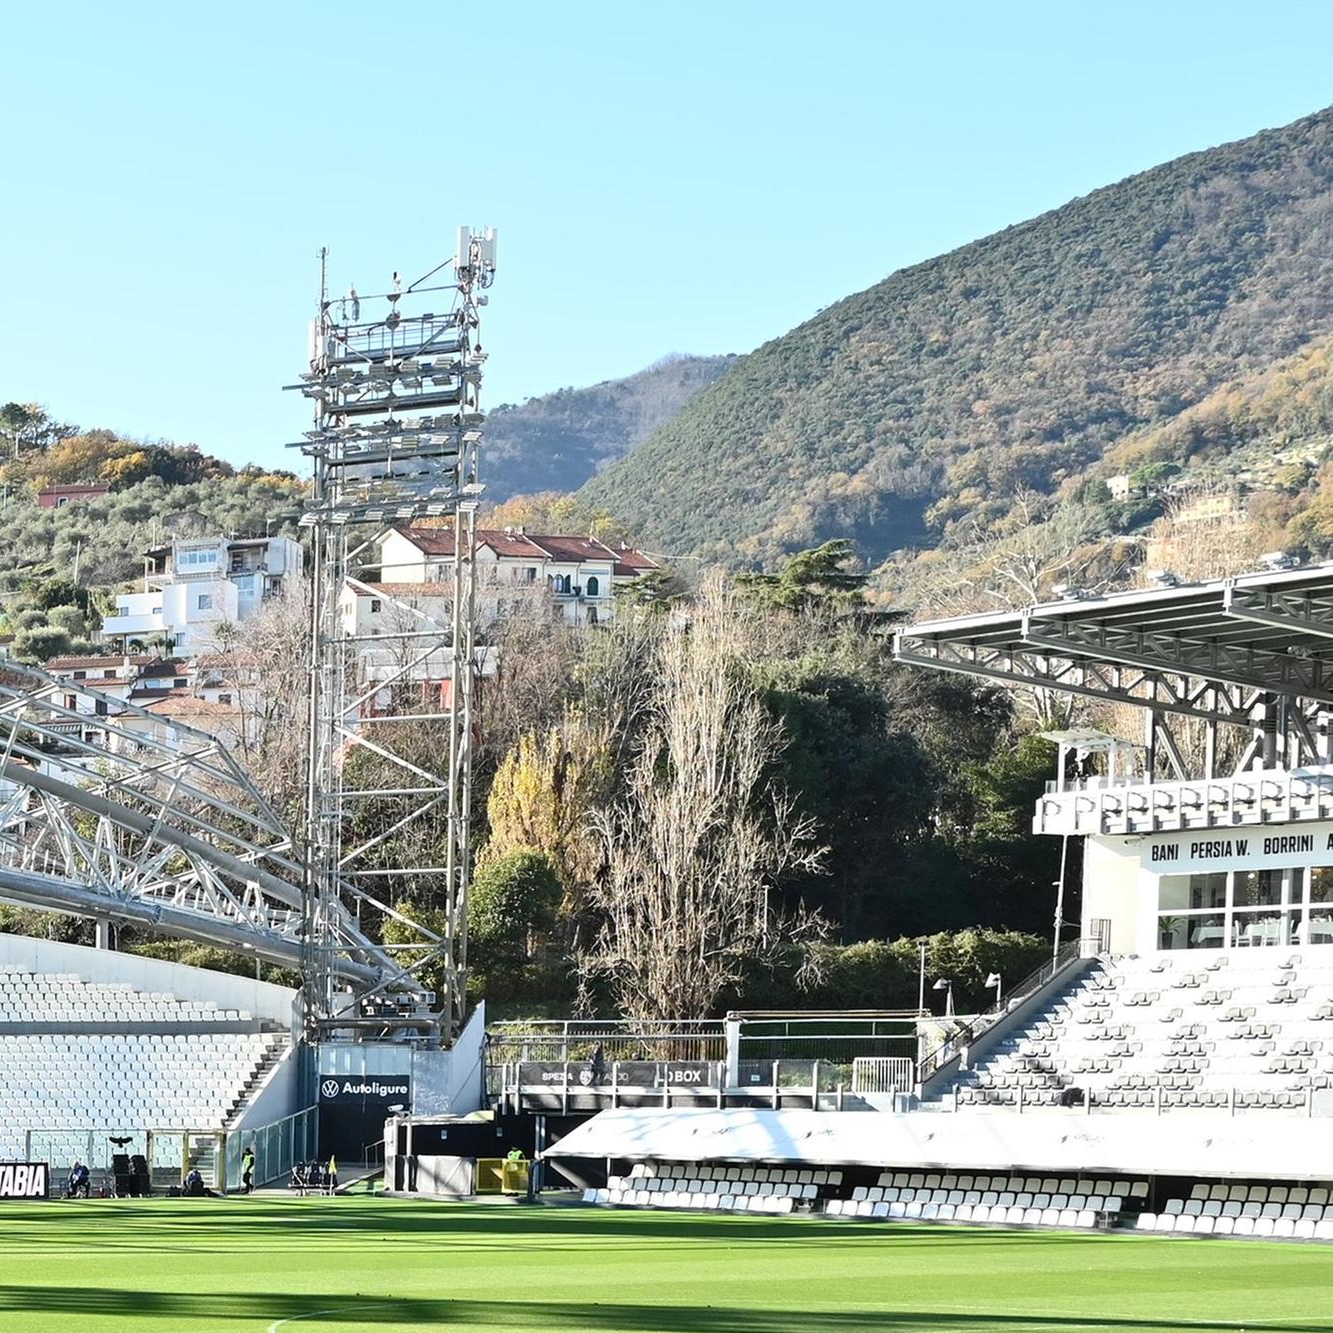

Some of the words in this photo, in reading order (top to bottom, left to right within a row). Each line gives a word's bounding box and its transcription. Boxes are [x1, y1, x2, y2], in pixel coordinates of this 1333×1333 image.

[1151, 844, 1179, 861] BANI
[1190, 840, 1232, 859] PERSIA
[1236, 839, 1251, 856] W.
[1263, 835, 1314, 855] BORRINI
[541, 1072, 573, 1081] SPEZA
[674, 1070, 701, 1082] BOX
[342, 1081, 409, 1098] Autoligure
